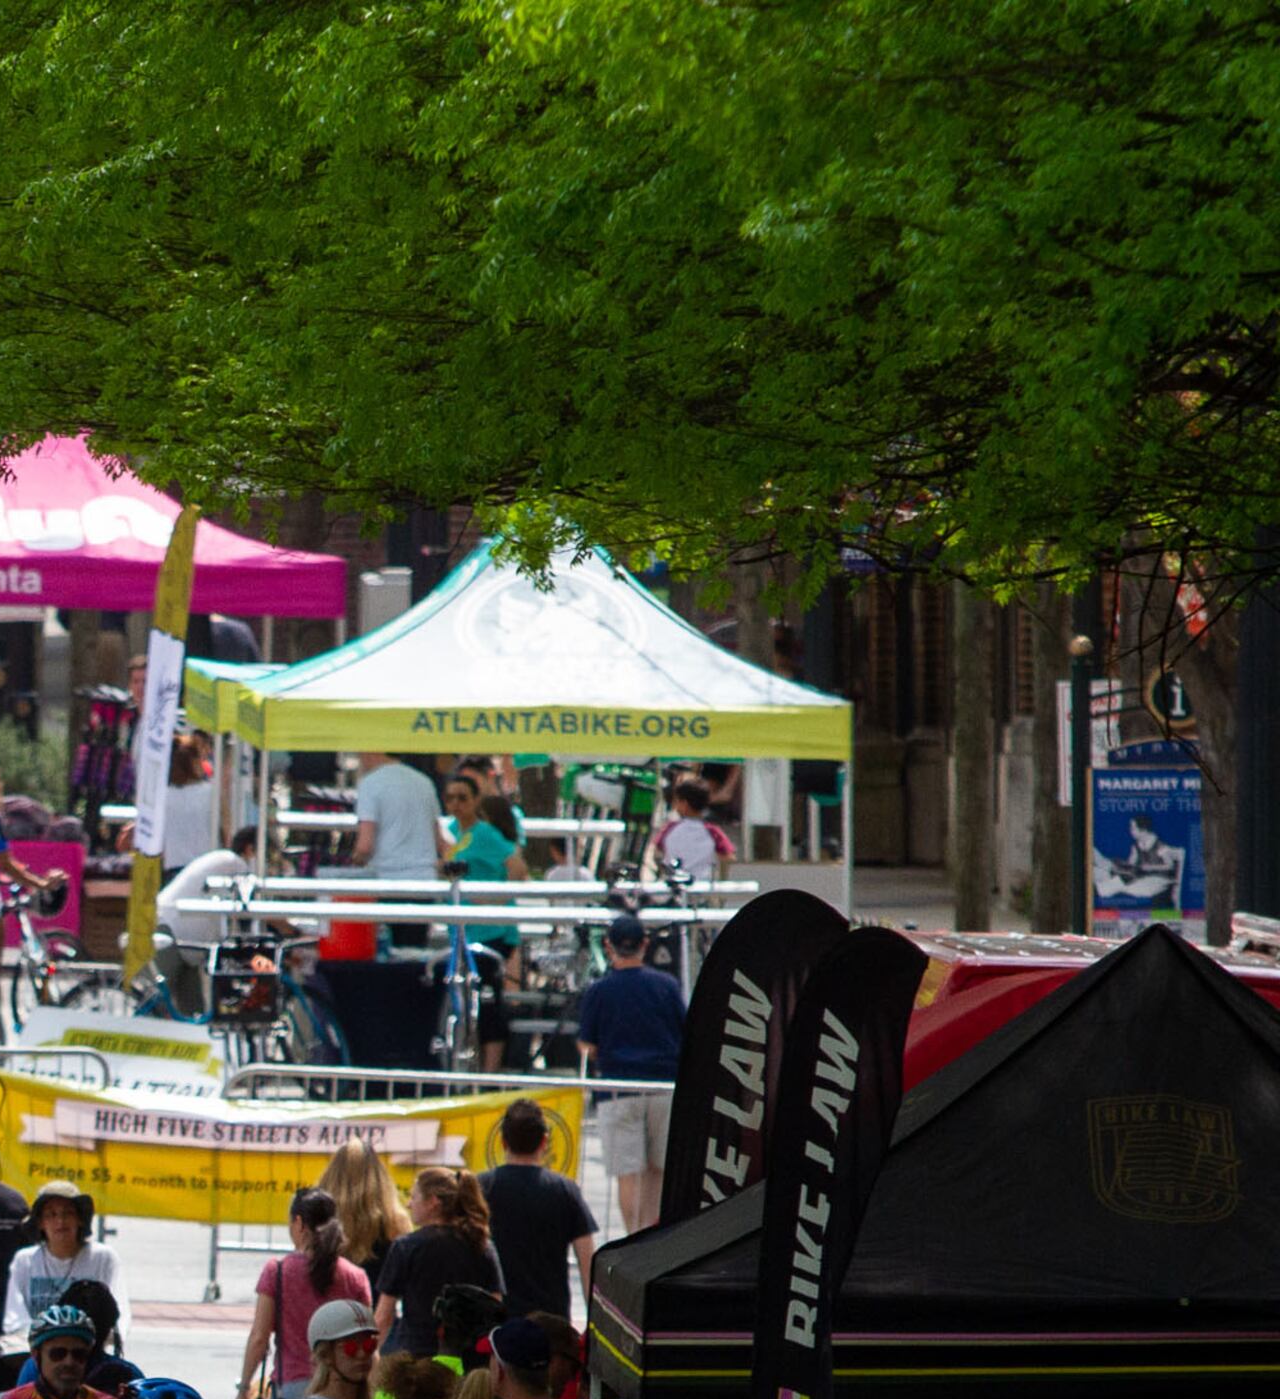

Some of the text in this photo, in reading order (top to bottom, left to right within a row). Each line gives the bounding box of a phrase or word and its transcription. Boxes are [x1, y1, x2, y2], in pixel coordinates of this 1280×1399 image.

[411, 710, 711, 739] ATLANTABIKE.ORG
[1098, 778, 1178, 791] MARGARET
[1099, 799, 1149, 813] STORY
[1152, 799, 1171, 813] OF
[713, 968, 773, 1132] LAW
[95, 1110, 387, 1146] HIGH FIVE STREETS ALIVE!
[28, 1162, 86, 1185] Pledge
[131, 1177, 186, 1191] month
[191, 1177, 208, 1191] to
[213, 1179, 279, 1197] support
